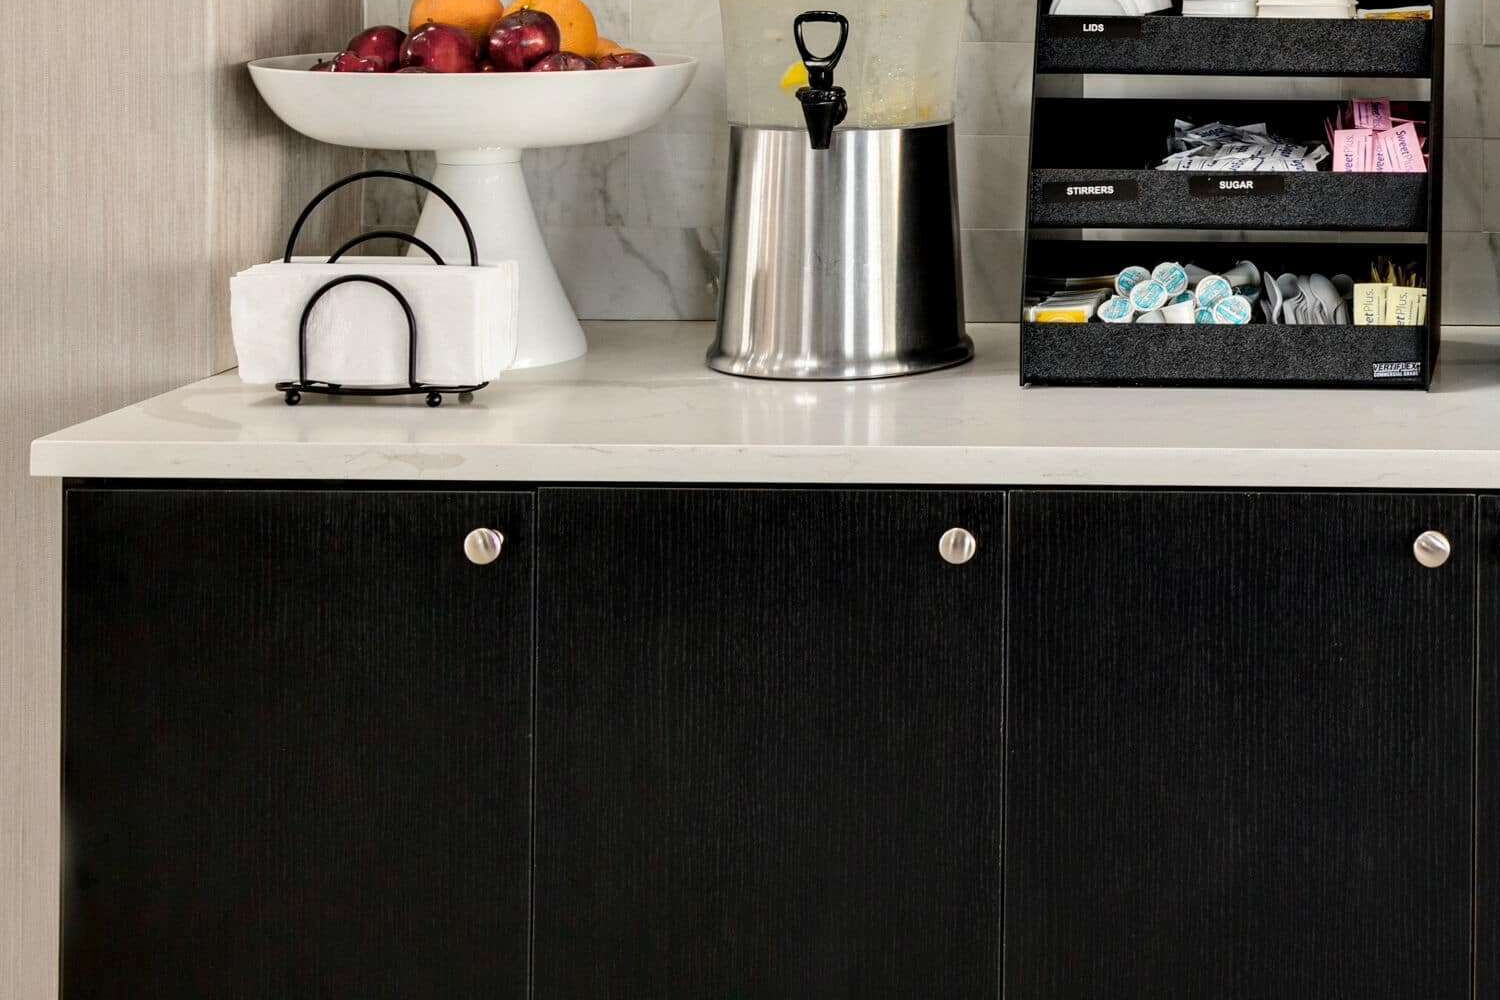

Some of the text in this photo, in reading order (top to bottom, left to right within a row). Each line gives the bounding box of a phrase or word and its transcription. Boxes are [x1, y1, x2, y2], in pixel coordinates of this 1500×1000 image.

[1082, 23, 1105, 32] LIDS
[1218, 180, 1254, 189] SUGAR
[1066, 185, 1115, 196] STIRRERS
